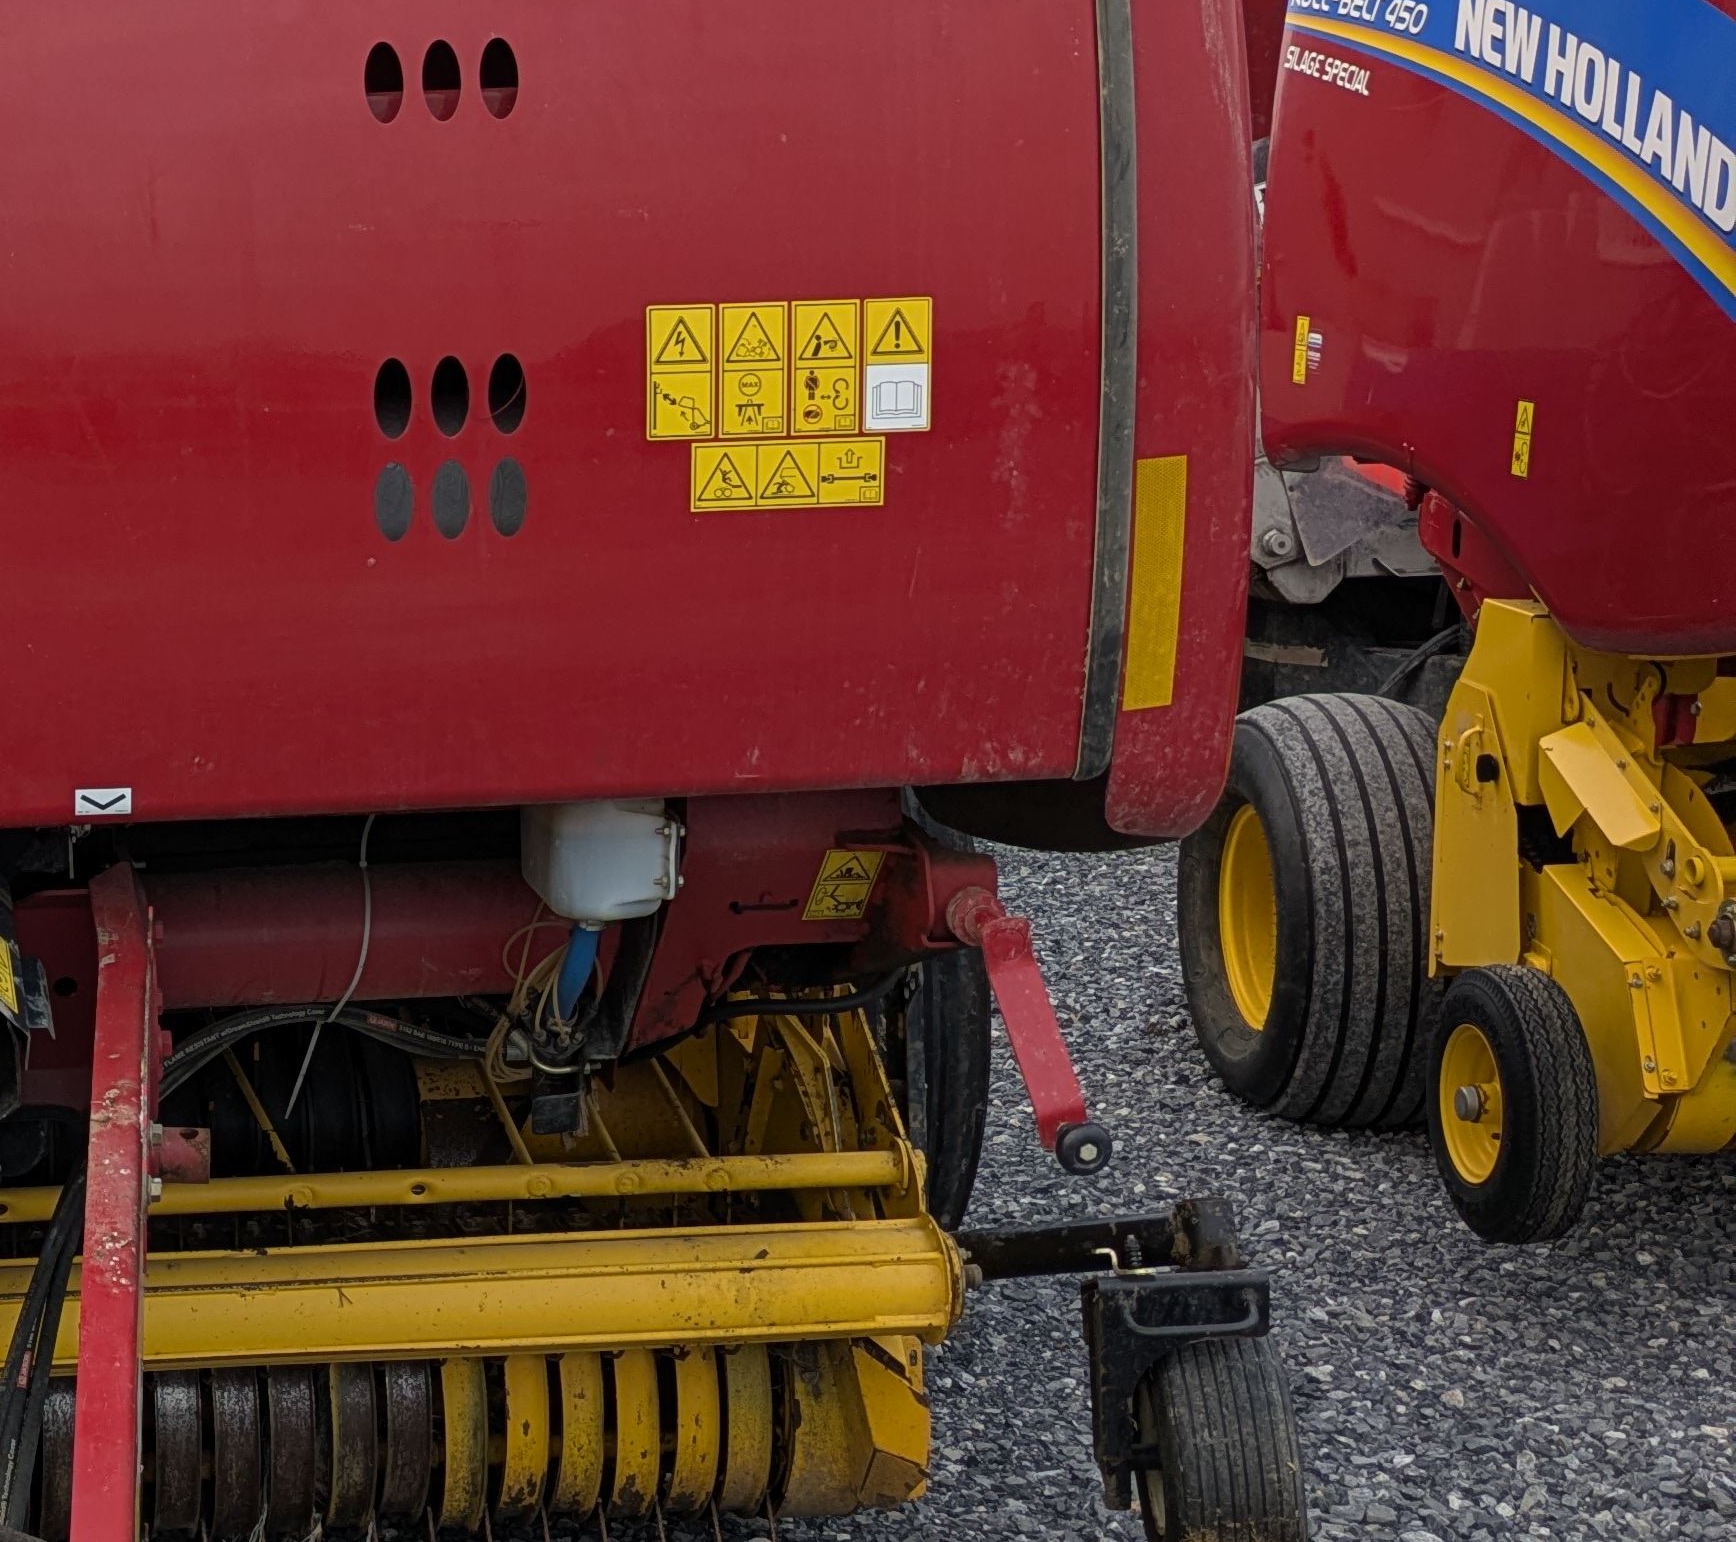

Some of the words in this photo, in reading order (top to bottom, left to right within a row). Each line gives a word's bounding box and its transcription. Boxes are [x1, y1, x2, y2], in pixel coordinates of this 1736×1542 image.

[1283, 45, 1325, 78] SILAGE
[1322, 57, 1371, 97] SPECIAL
[1544, 22, 1736, 232] HOLLAND
